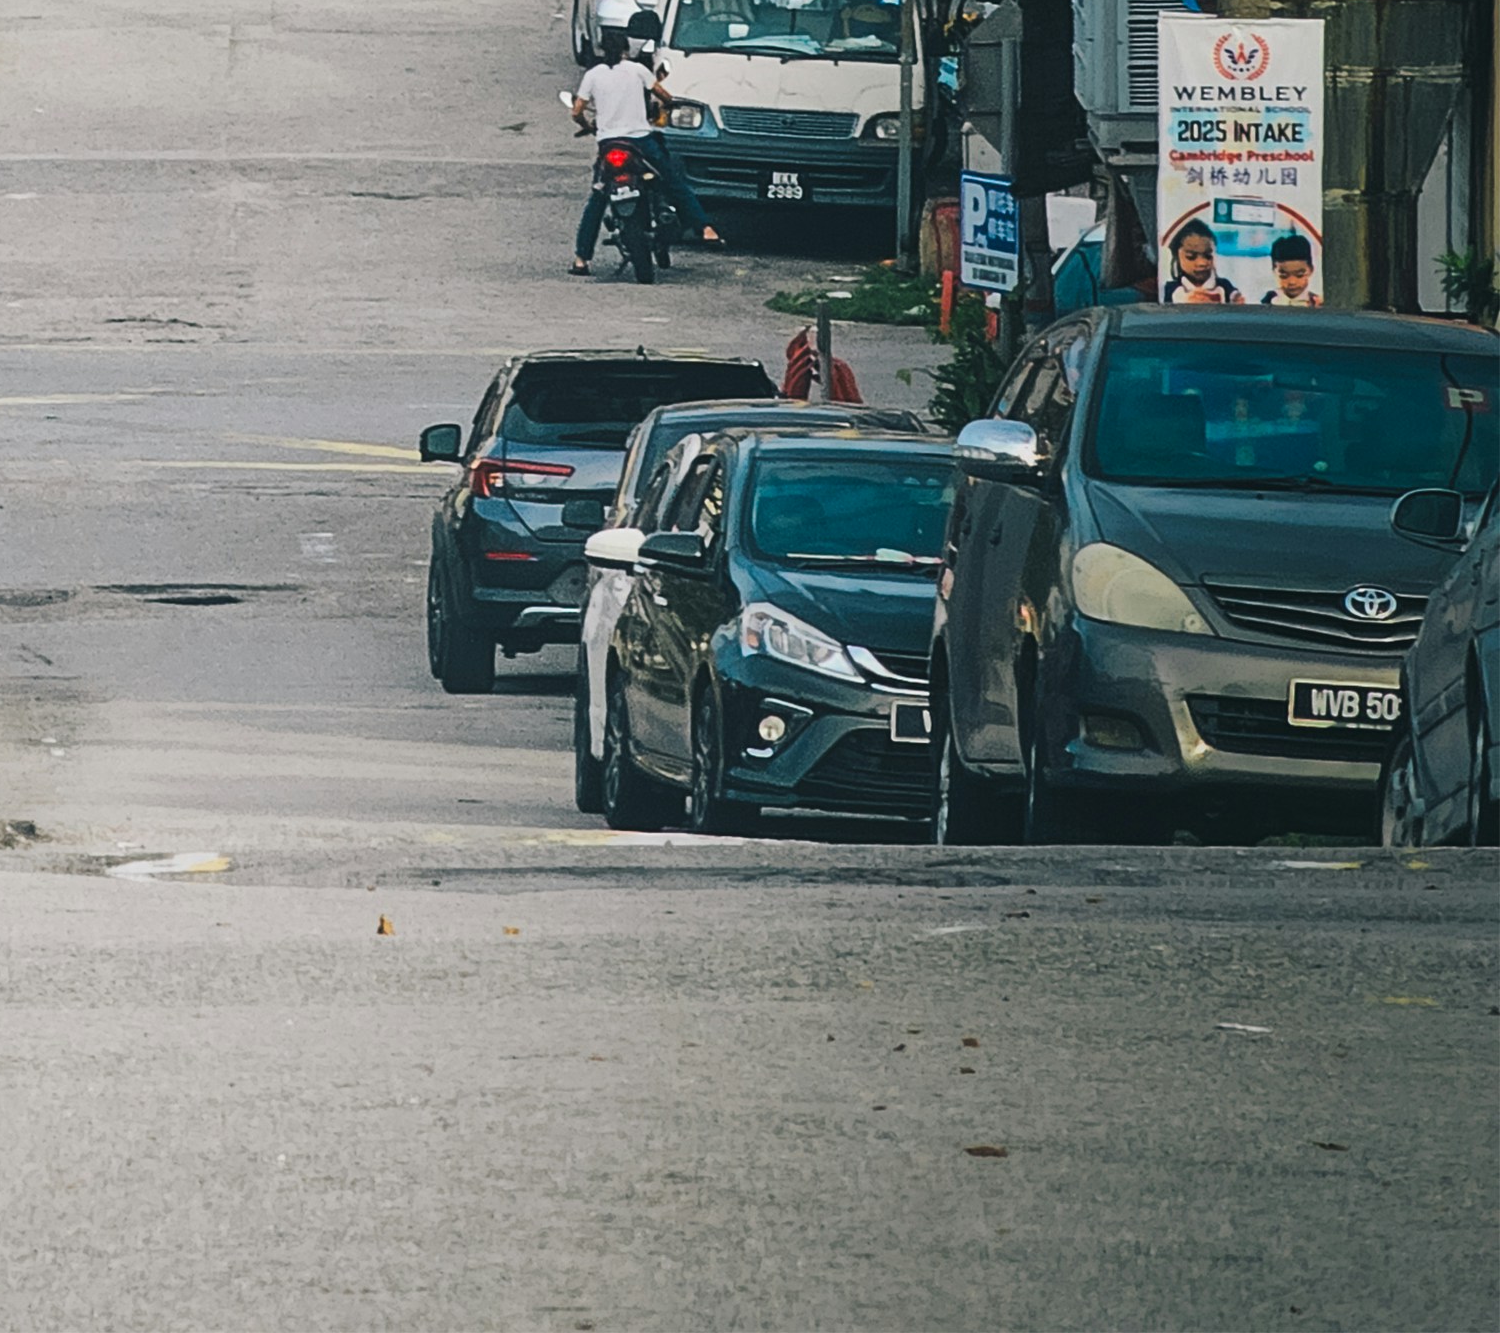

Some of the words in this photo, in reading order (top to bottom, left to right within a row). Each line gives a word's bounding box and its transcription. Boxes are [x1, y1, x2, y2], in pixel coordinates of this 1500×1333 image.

[1173, 85, 1307, 102] WEMBLEY
[1170, 105, 1262, 114] INTERNATIONAL
[1264, 105, 1312, 114] SCHOOL
[1177, 119, 1227, 143] 2025
[1168, 149, 1243, 165] Cambridge
[1246, 149, 1315, 162] Preschool
[1186, 166, 1298, 187] 剑桥幼儿园
[767, 184, 803, 200] 2989
[963, 181, 987, 244] P
[1311, 688, 1360, 718] WVB
[1366, 691, 1403, 721] 50
